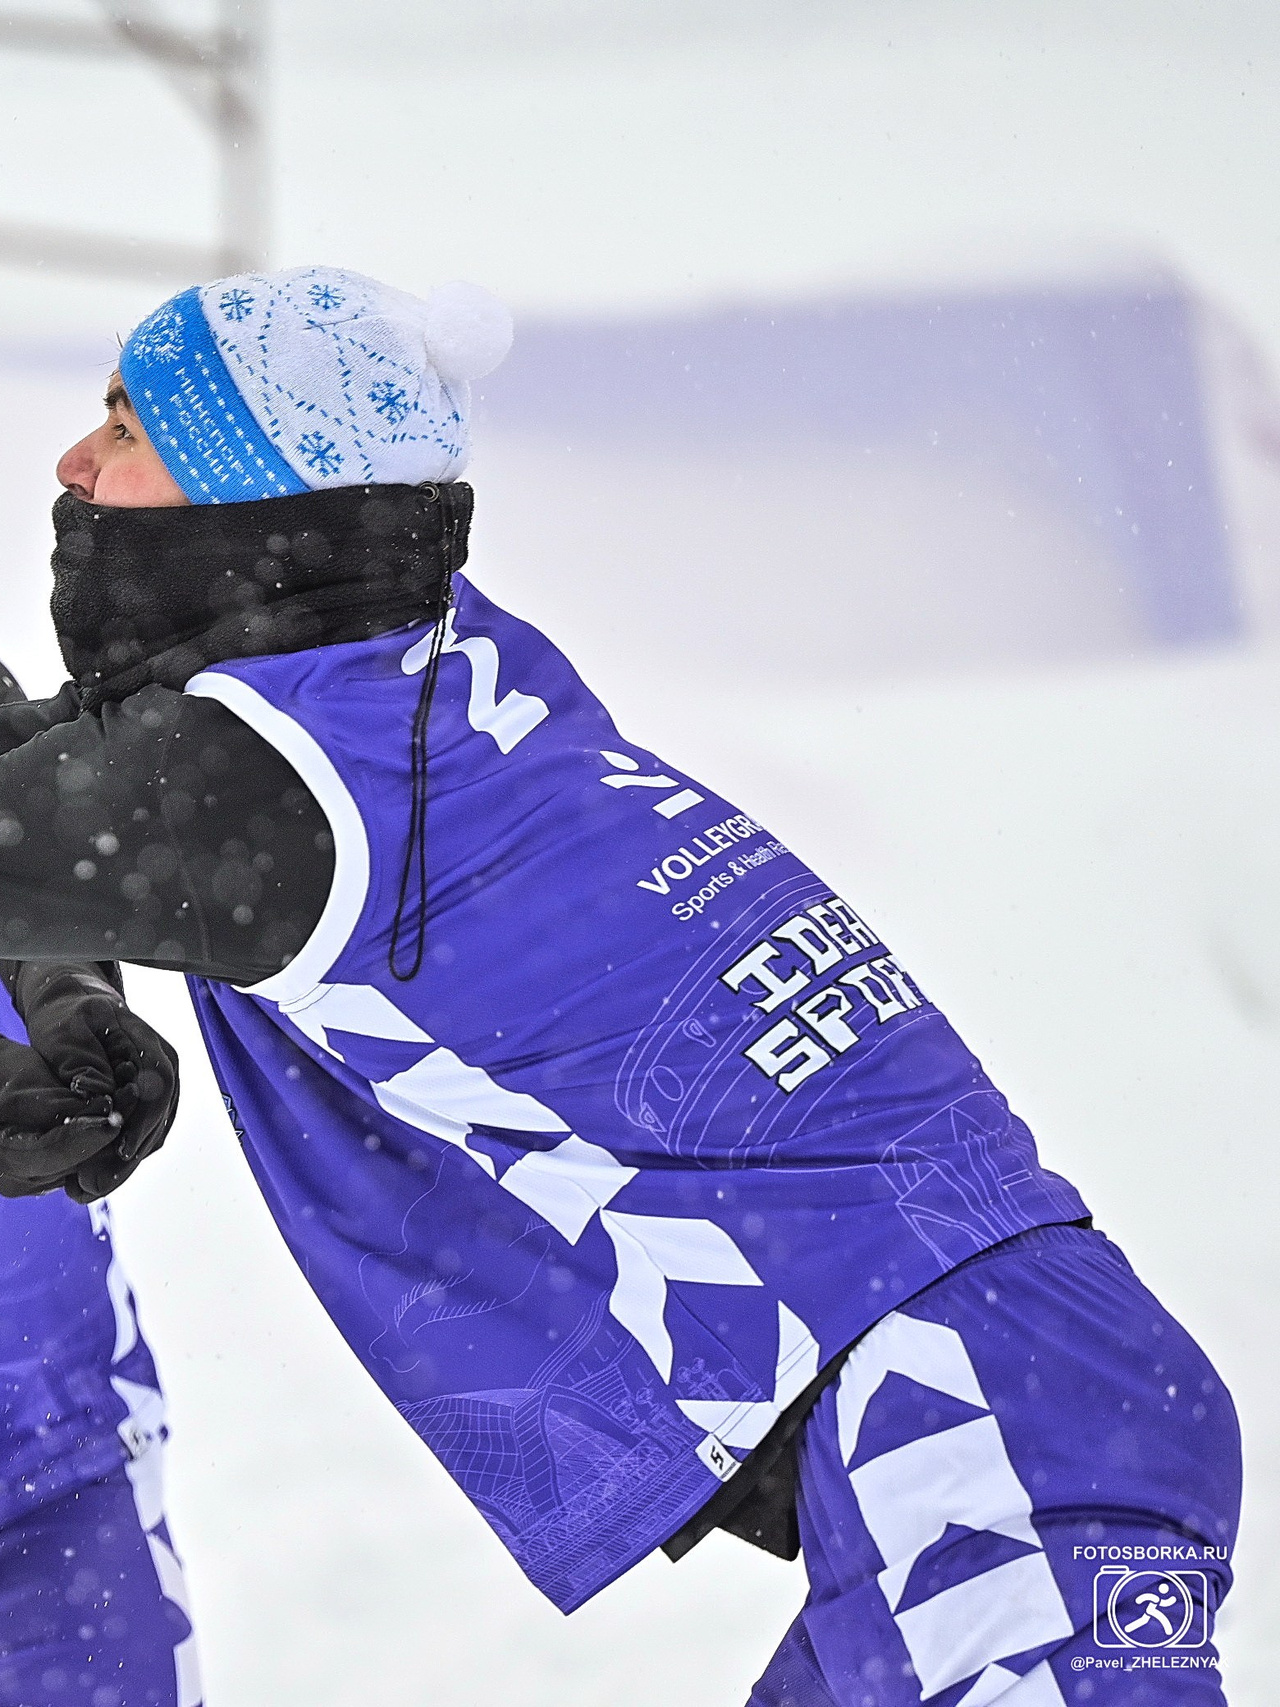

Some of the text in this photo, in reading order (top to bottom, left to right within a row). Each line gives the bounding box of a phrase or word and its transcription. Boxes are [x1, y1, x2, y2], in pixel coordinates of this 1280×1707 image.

[168, 393, 231, 484] РОССИИ
[174, 366, 255, 486] МИНСПОРТ
[636, 813, 765, 896] VOLLEYGR
[671, 871, 735, 921] Sports
[727, 860, 748, 877] &
[737, 845, 778, 870] Health
[720, 897, 880, 1015] IDEA
